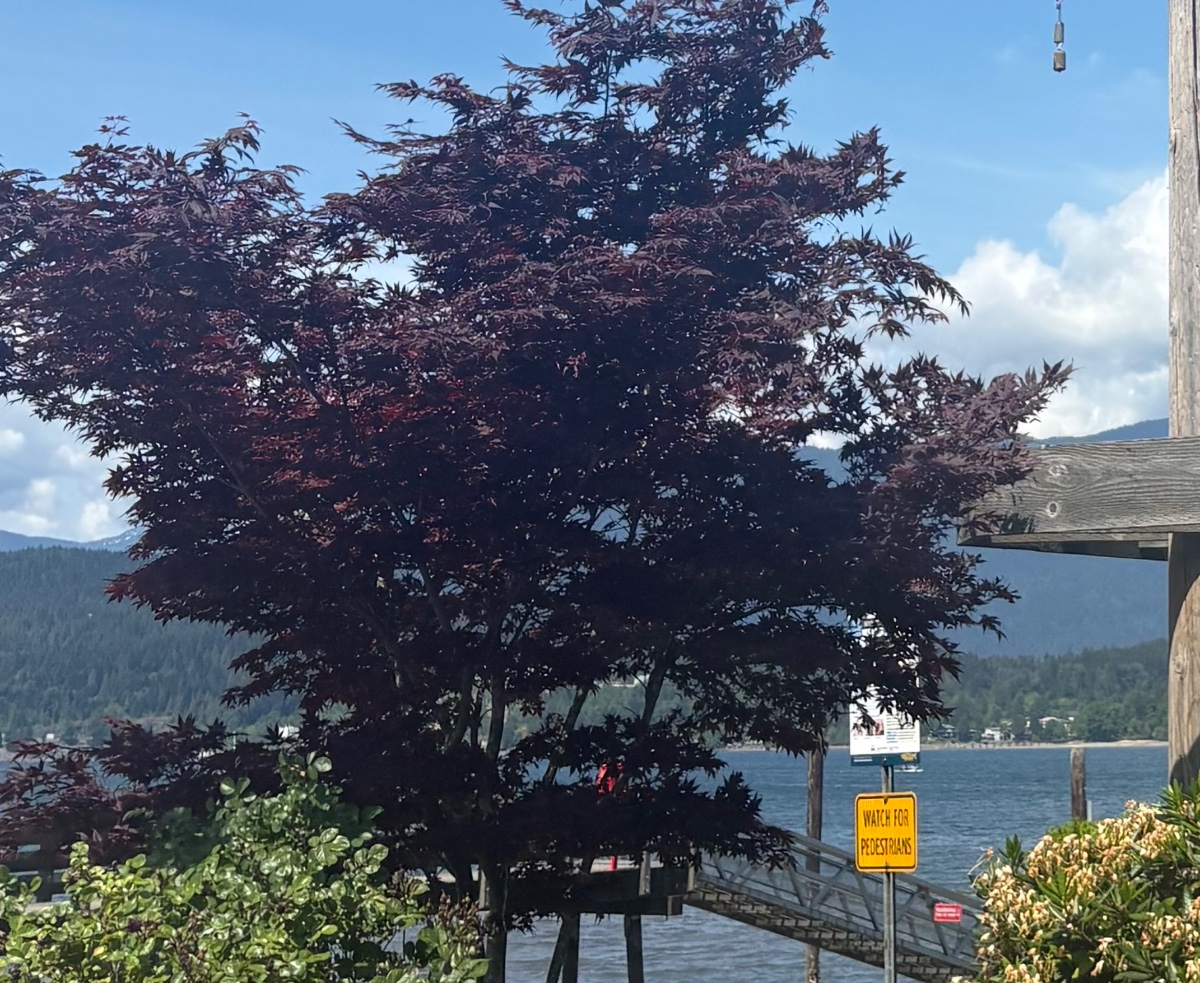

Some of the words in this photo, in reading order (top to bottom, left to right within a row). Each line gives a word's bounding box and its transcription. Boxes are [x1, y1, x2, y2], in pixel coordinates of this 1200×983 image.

[863, 809, 891, 827] WATCH
[894, 808, 909, 827] FOR
[861, 837, 912, 856] PEDESTRIANS
